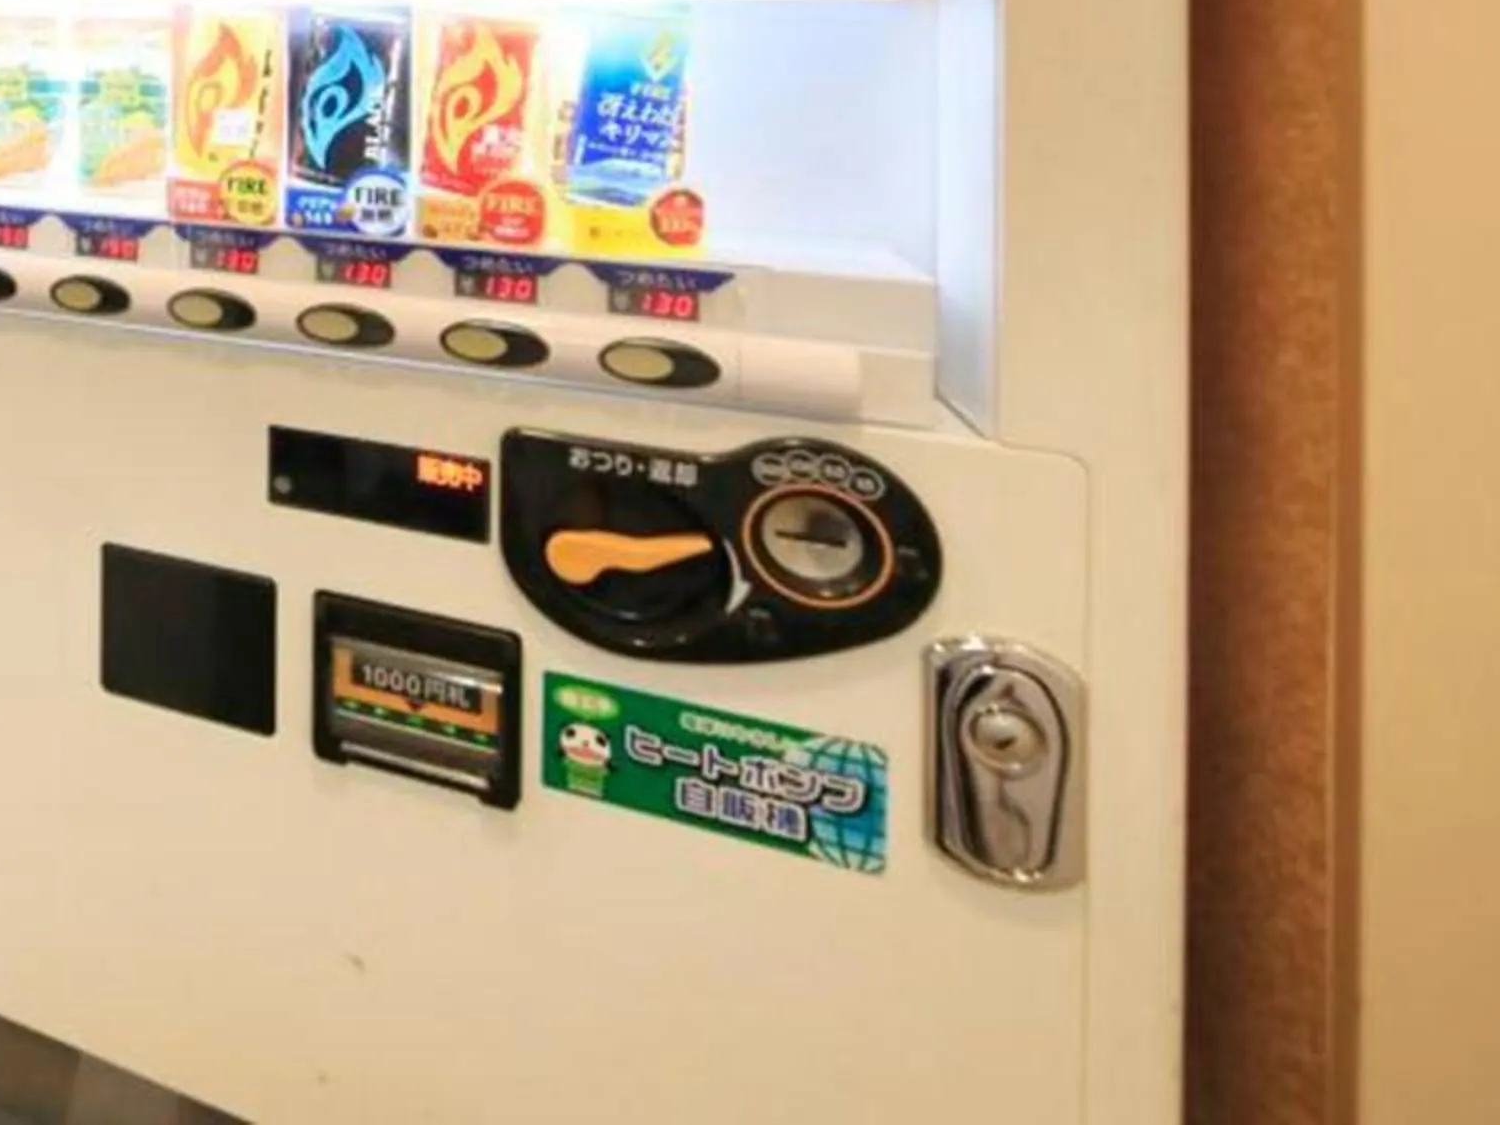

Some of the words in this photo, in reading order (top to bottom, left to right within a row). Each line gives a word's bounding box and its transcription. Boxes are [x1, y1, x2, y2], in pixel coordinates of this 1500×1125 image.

[227, 177, 268, 196] FIRE
[355, 186, 403, 206] FIRE
[361, 663, 471, 709] 1000円札
[675, 775, 810, 842] 自販機
